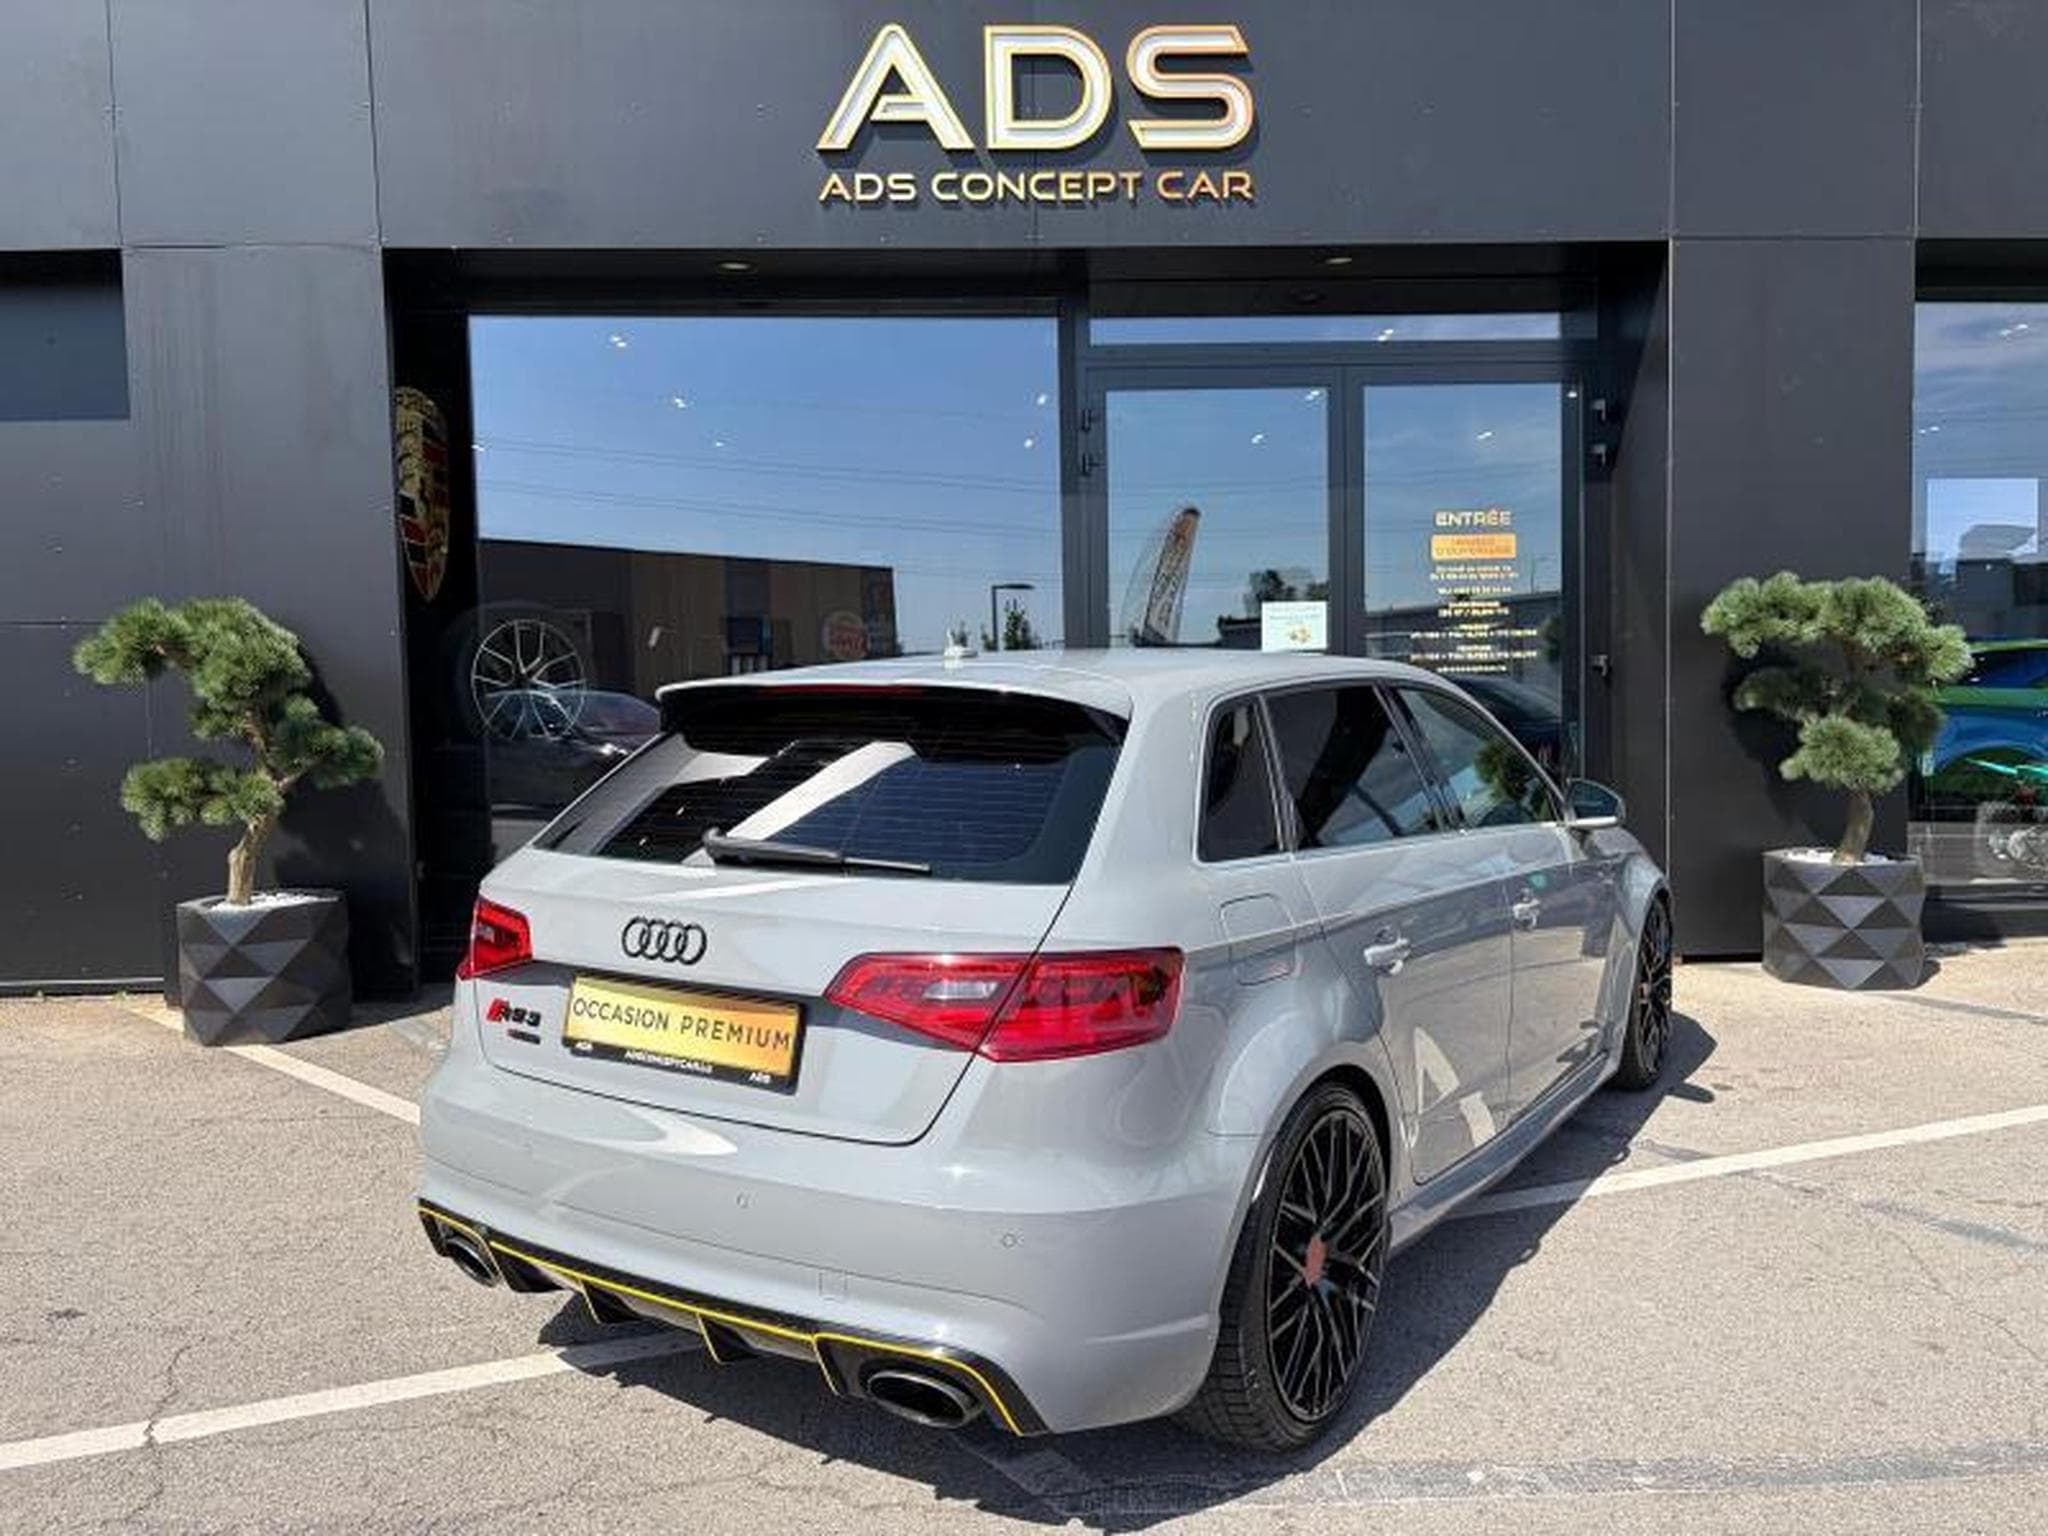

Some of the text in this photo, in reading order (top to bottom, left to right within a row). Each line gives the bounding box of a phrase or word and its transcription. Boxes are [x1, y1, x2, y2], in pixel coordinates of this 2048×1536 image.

[816, 23, 1254, 150] ADS
[819, 170, 1254, 201] ADS CONCEPT CAR
[1435, 509, 1512, 527] ENTRÉE
[572, 997, 791, 1050] OCCASION PREMIUM
